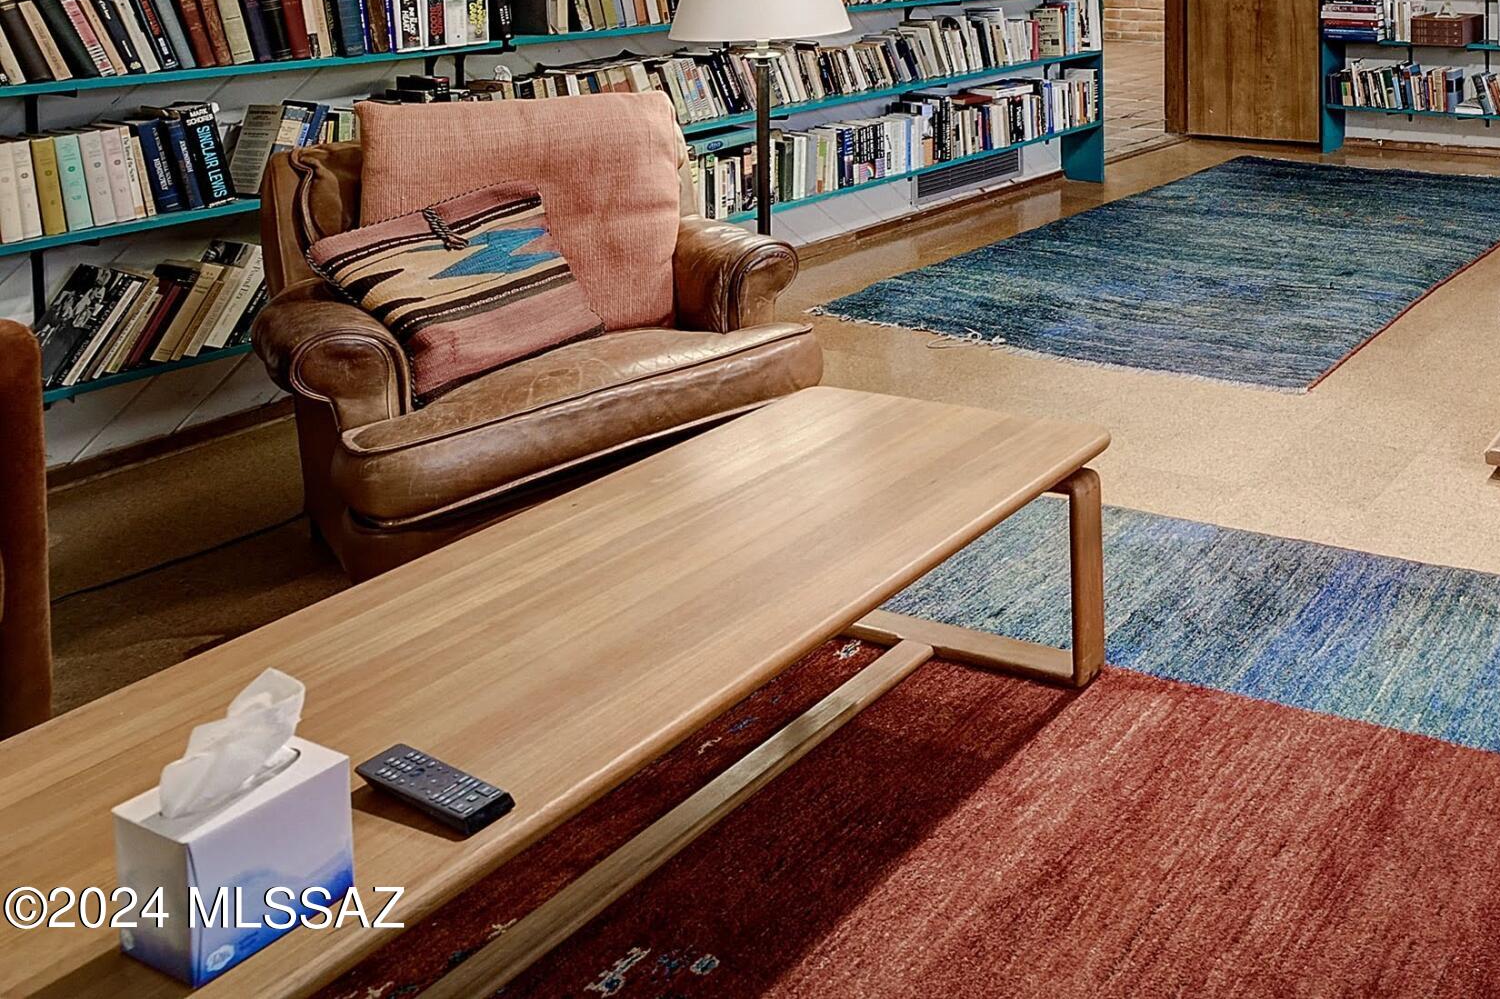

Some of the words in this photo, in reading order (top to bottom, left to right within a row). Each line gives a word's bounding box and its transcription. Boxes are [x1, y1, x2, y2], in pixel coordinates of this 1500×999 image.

[401, 9, 409, 31] HEART
[190, 107, 209, 119] MARK
[196, 126, 216, 168] SINCLAIR
[207, 169, 228, 198] LEWIS
[242, 263, 260, 289] Pound
